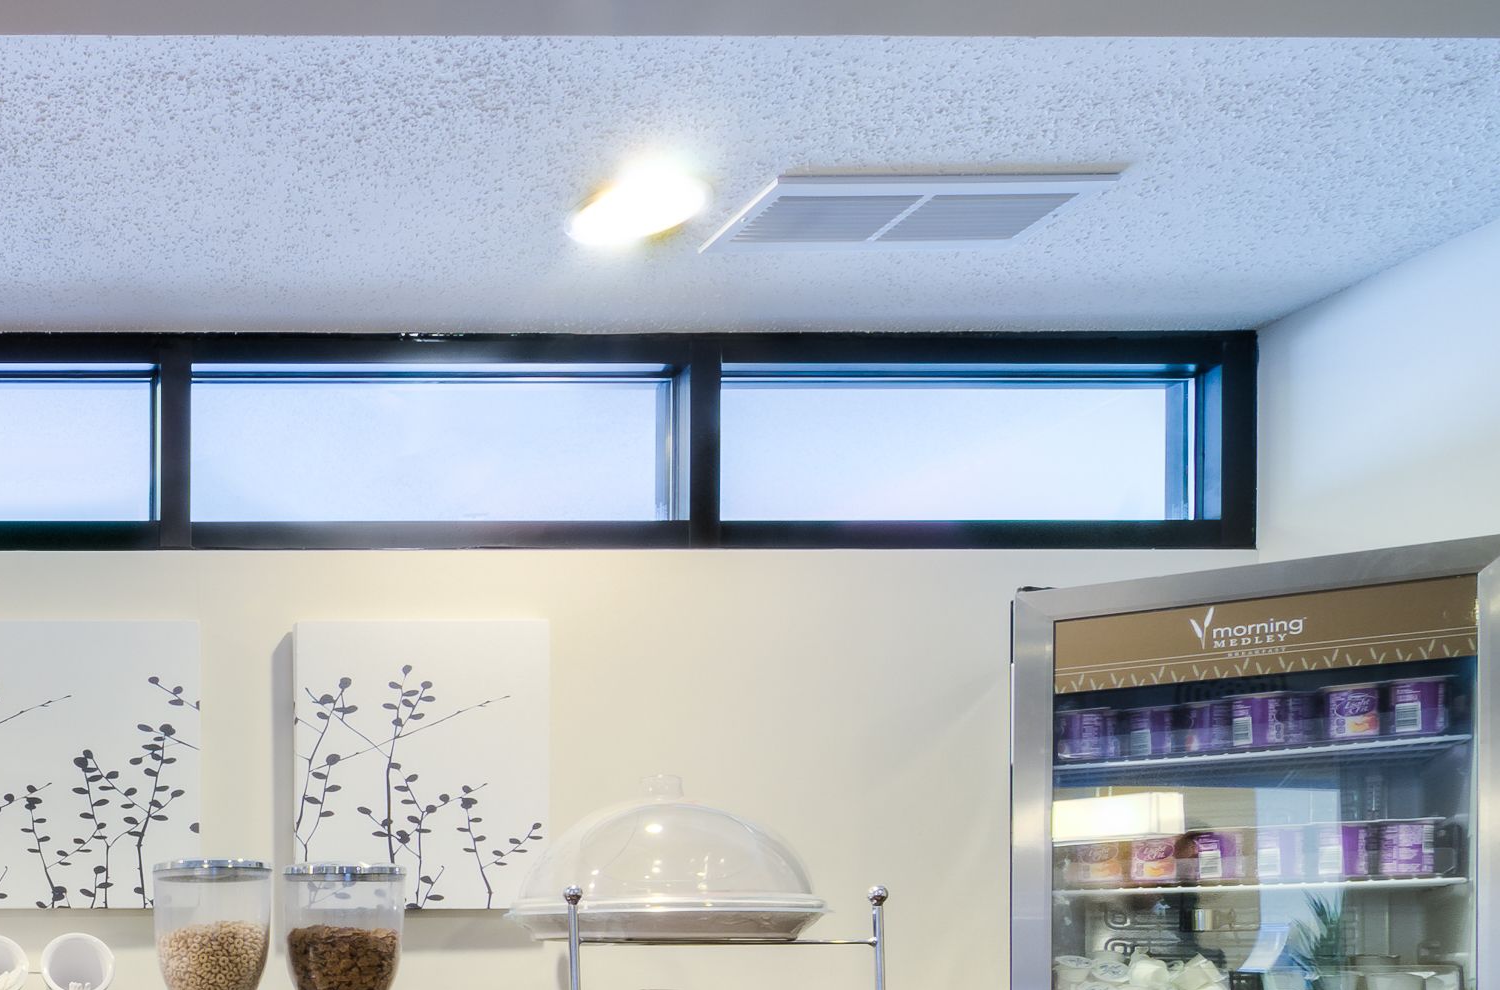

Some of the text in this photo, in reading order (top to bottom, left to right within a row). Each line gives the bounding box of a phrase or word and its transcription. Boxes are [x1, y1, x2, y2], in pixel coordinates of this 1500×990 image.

[1213, 618, 1303, 638] morning
[1213, 634, 1288, 648] MEDLEY
[1228, 648, 1287, 657] BREAKFAST
